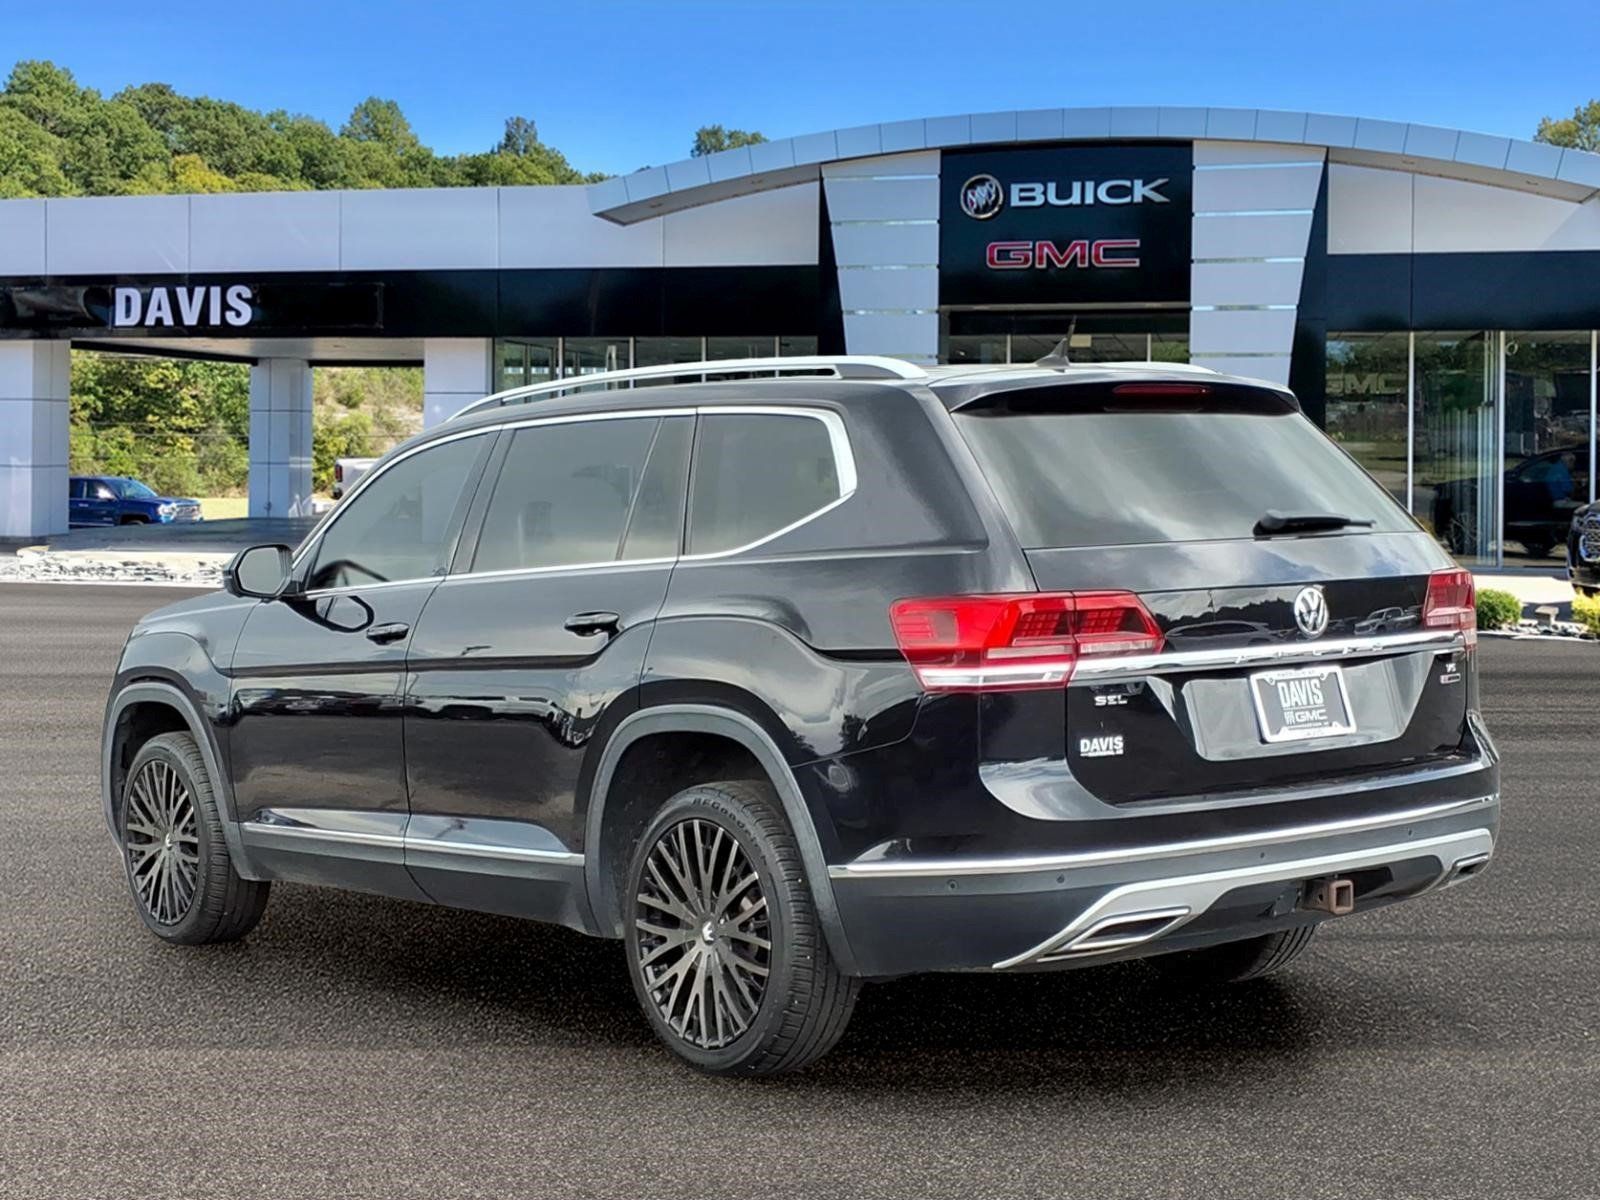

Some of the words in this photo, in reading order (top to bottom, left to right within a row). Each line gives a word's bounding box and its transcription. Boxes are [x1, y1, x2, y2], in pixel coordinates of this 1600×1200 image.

[1010, 178, 1170, 207] BUICK
[986, 238, 1141, 269] GMC
[114, 285, 253, 327] DAVIS
[1094, 694, 1128, 706] SEL
[1277, 678, 1324, 708] DAVIS
[1294, 708, 1328, 723] GMC
[1080, 734, 1124, 753] DAVIS
